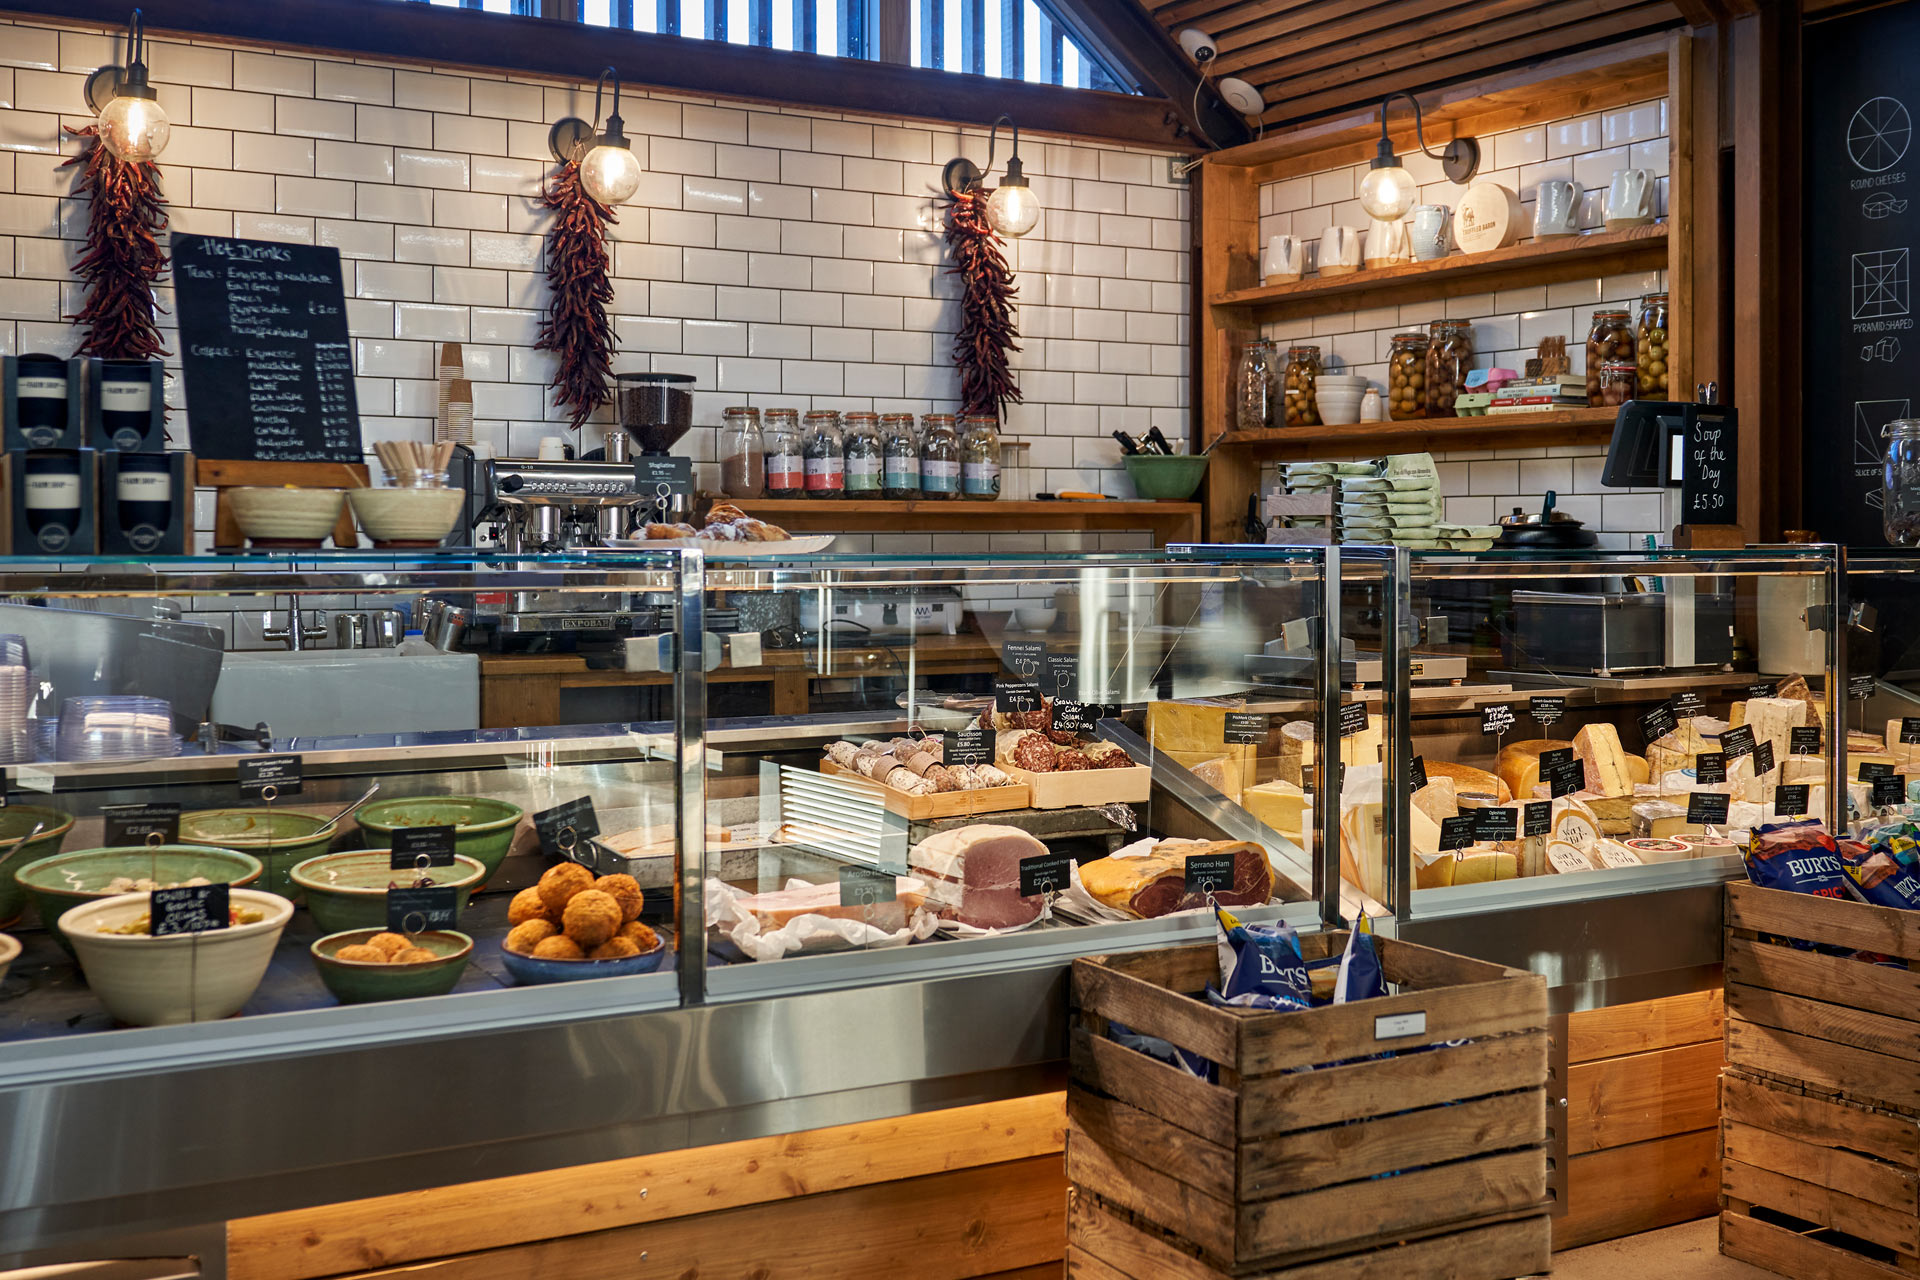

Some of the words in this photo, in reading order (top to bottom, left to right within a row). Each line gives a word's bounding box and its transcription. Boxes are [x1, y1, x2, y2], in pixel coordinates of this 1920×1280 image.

[1851, 178, 1874, 190] ROUND
[1875, 172, 1906, 186] CHEESES
[198, 238, 235, 257] Hot
[237, 244, 292, 261] Drinks
[1694, 421, 1721, 446] Soup
[1694, 449, 1706, 468] of
[1710, 446, 1726, 461] the
[1702, 464, 1721, 489] Day
[1693, 493, 1724, 510] £5.50
[1061, 712, 1084, 721] Salami
[1786, 855, 1842, 877] BURTS
